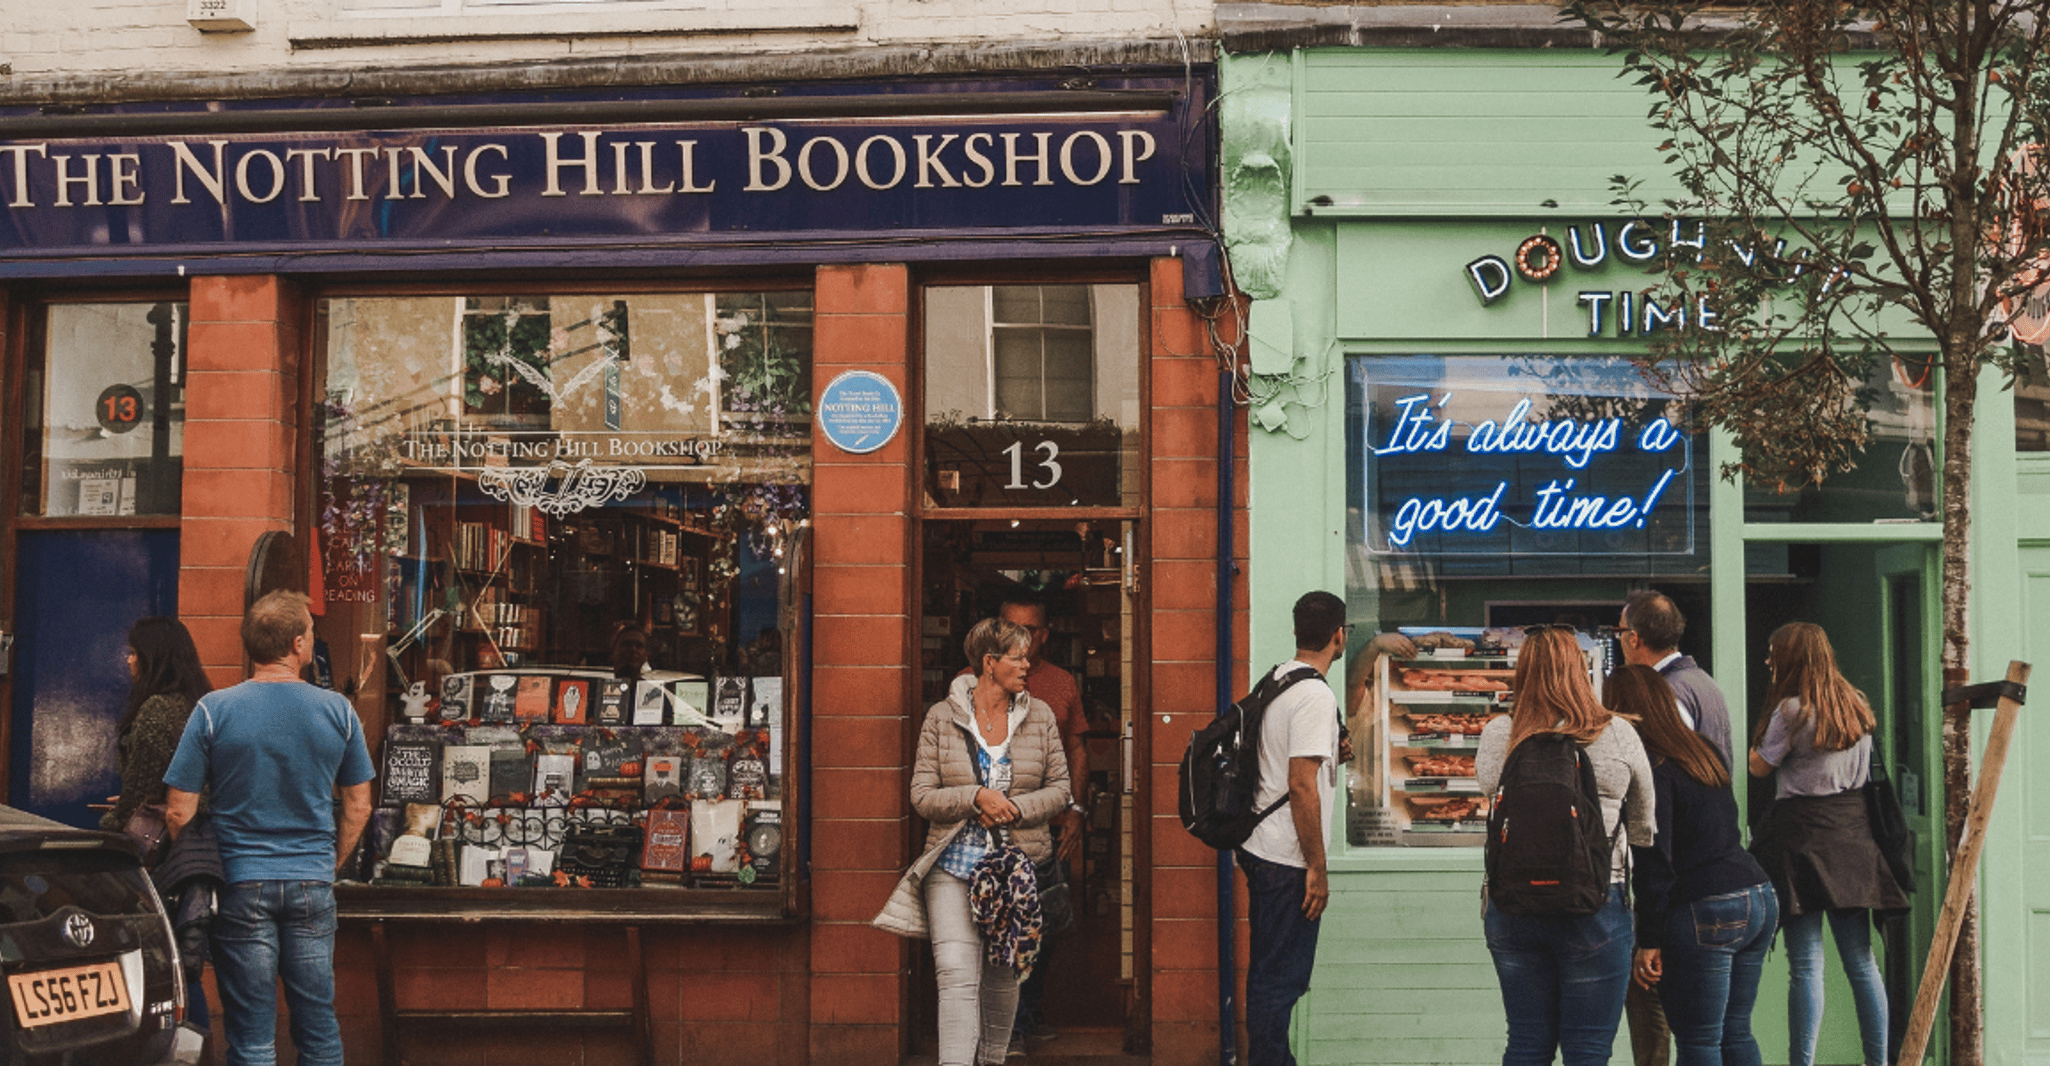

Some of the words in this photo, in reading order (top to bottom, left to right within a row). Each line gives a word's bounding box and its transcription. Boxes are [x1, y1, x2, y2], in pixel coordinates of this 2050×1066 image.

[0, 142, 146, 207] THE
[168, 140, 512, 204] NOTTING
[539, 130, 715, 196] HILL
[742, 127, 1156, 192] BOOKSHOP
[1577, 291, 1724, 336] TIME
[103, 395, 137, 422] 13
[824, 403, 870, 412] NOTTING
[872, 403, 895, 412] HILL
[1374, 391, 1453, 455] It's
[1467, 397, 1621, 468] always
[1640, 418, 1680, 451] a
[404, 439, 447, 458] THE
[453, 439, 550, 458] NOTTING
[555, 438, 604, 457] HILL
[609, 437, 723, 457] BOOKSHOP
[1002, 440, 1063, 490] 13
[1388, 481, 1507, 546] good
[1532, 468, 1676, 529] time!
[338, 575, 359, 587] ON
[18, 976, 78, 1019] LS56
[78, 972, 120, 1010] FZJ
